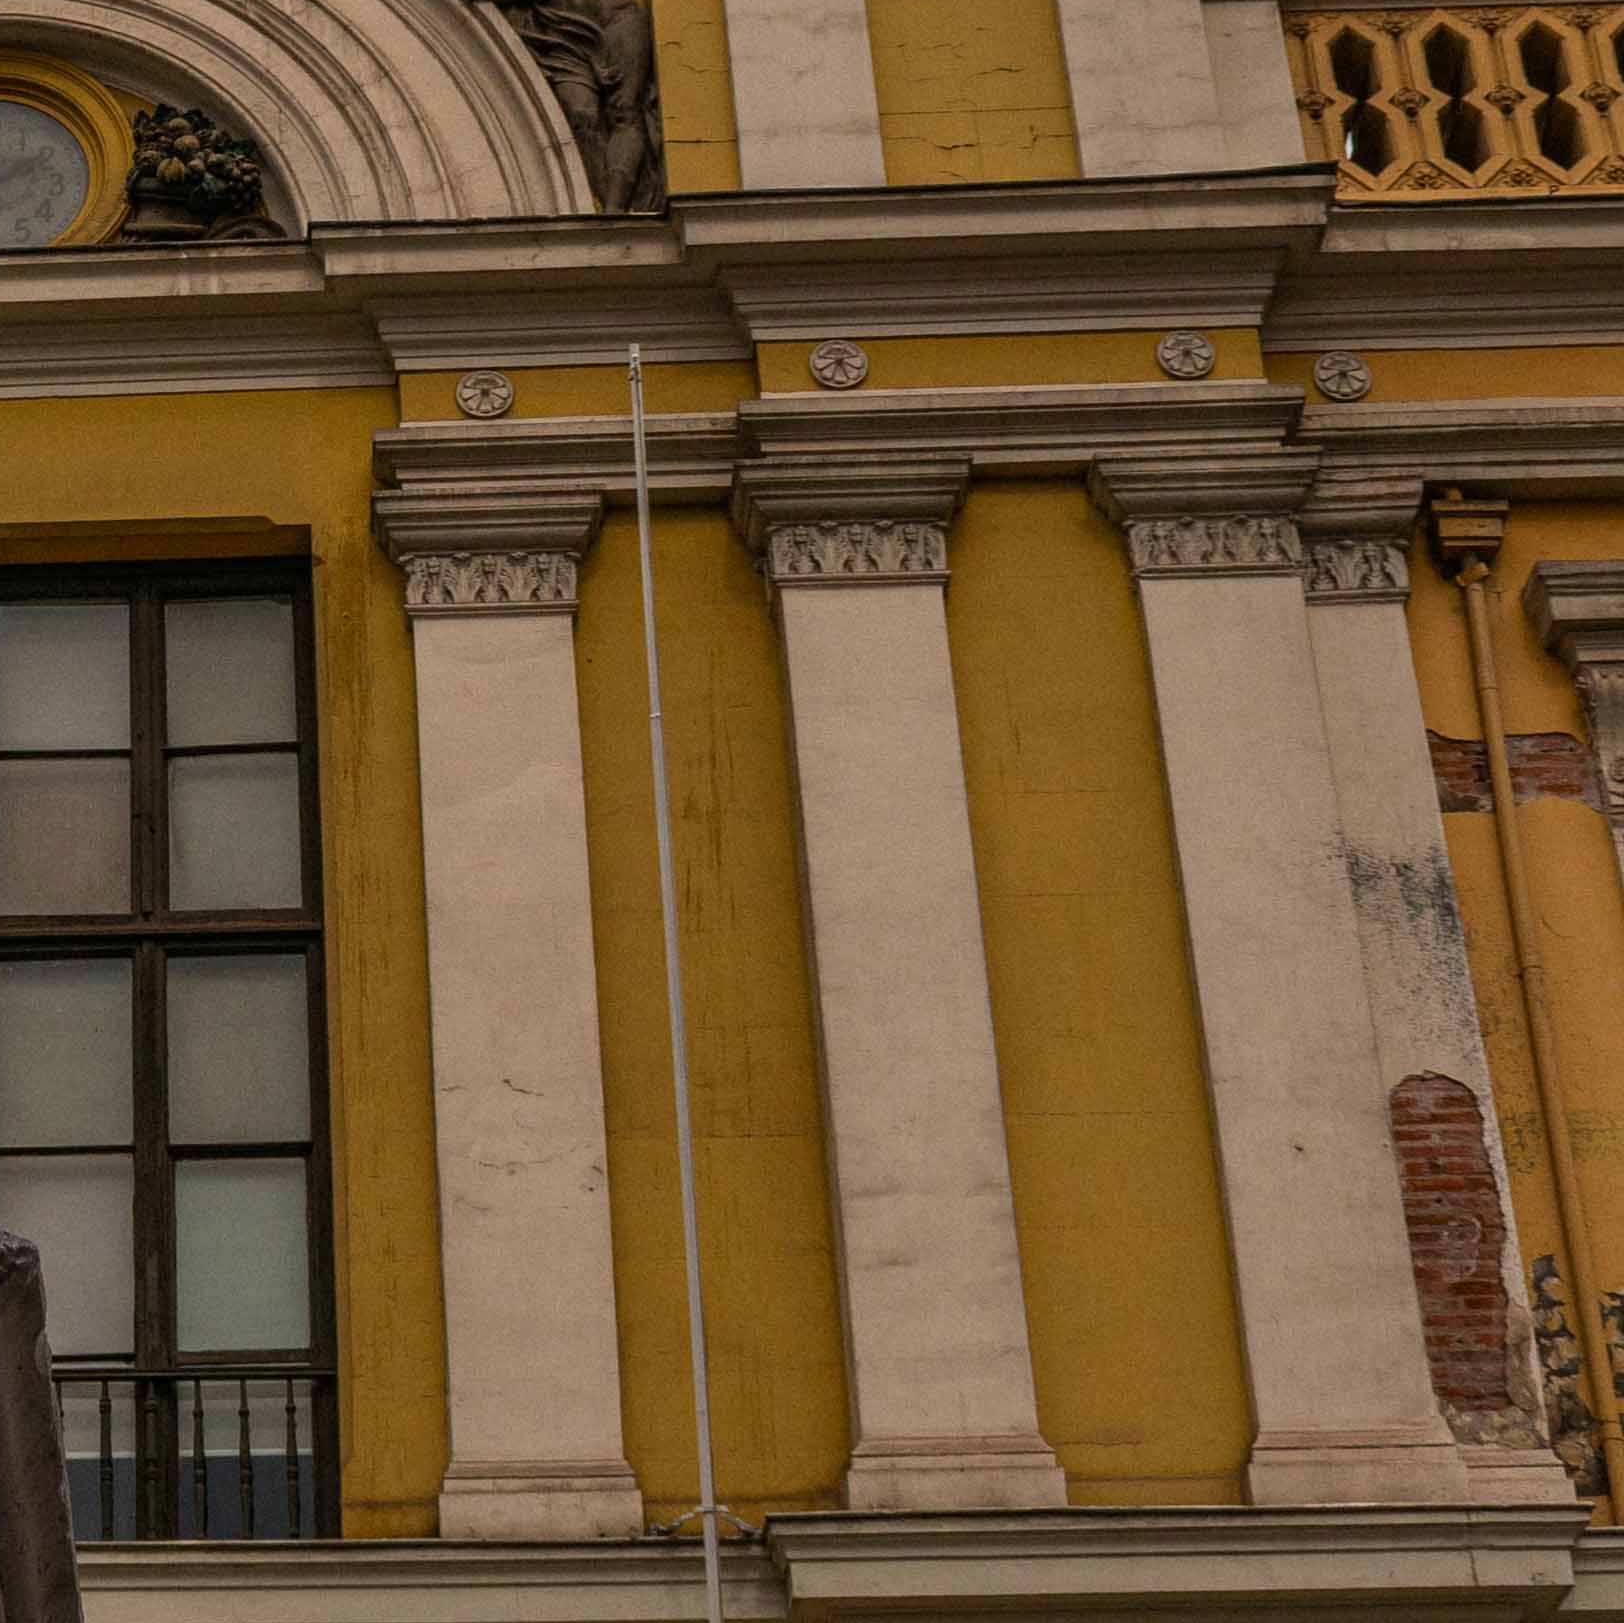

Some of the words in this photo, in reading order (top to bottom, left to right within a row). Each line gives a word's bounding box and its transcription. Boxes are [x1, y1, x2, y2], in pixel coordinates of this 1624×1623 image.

[38, 145, 55, 172] 2
[48, 173, 65, 197] 3
[34, 199, 54, 223] 4
[14, 218, 31, 243] 5
